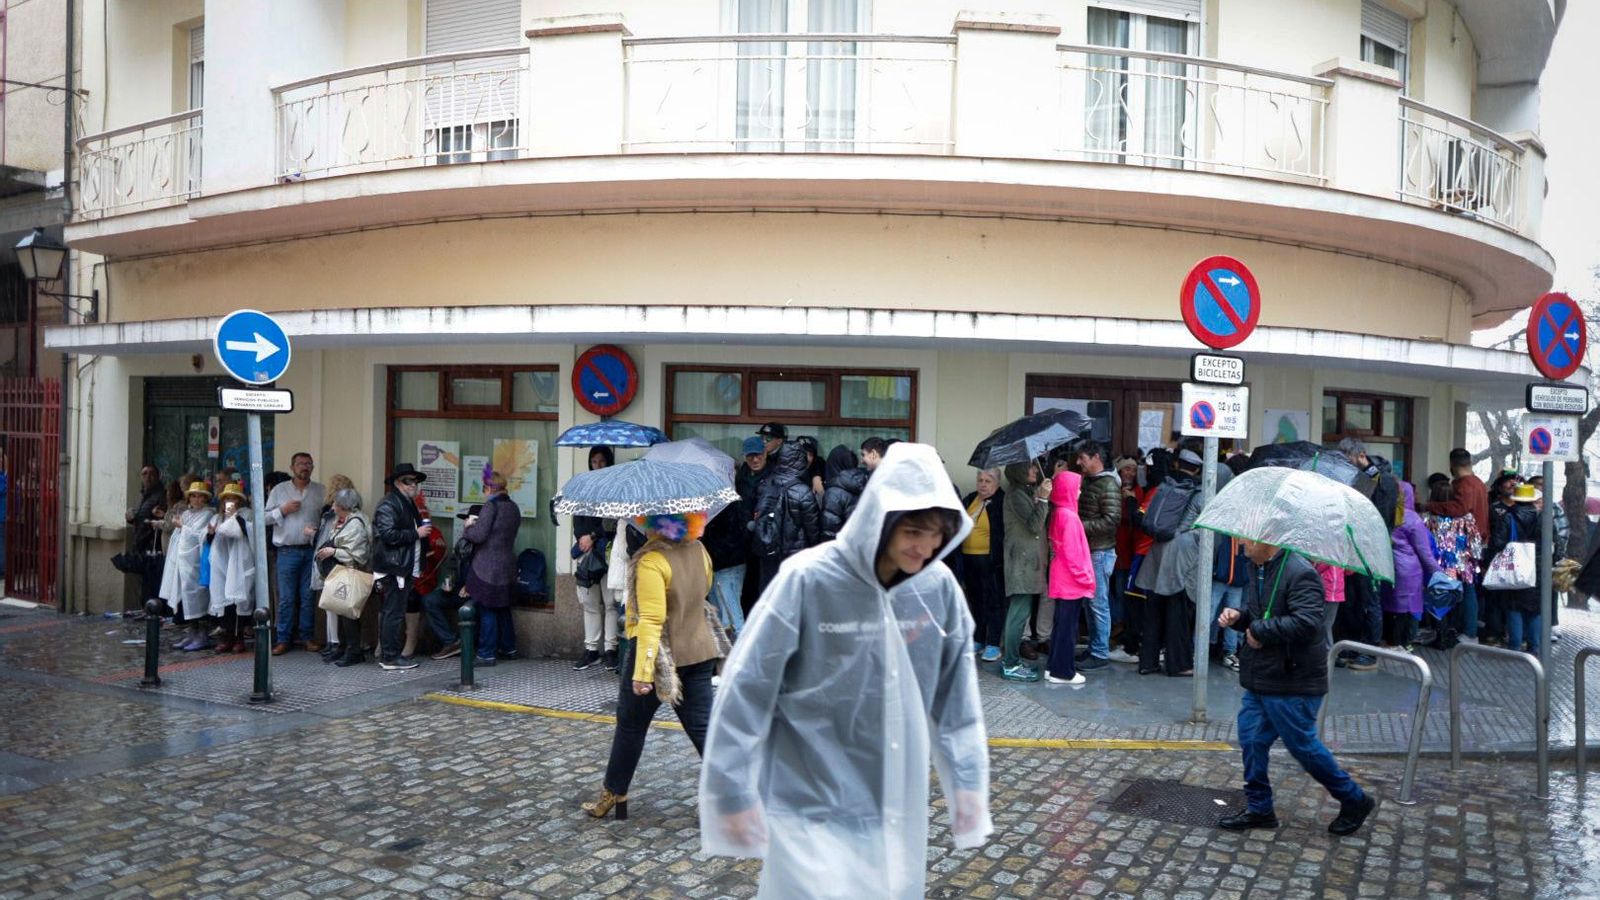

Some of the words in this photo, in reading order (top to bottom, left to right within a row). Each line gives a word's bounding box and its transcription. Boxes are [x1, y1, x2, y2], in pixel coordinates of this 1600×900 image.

[1203, 358, 1238, 369] EXCEPTO
[1198, 368, 1241, 379] BICICLETAS
[1563, 396, 1583, 404] PERSONAS
[1218, 401, 1226, 411] 02
